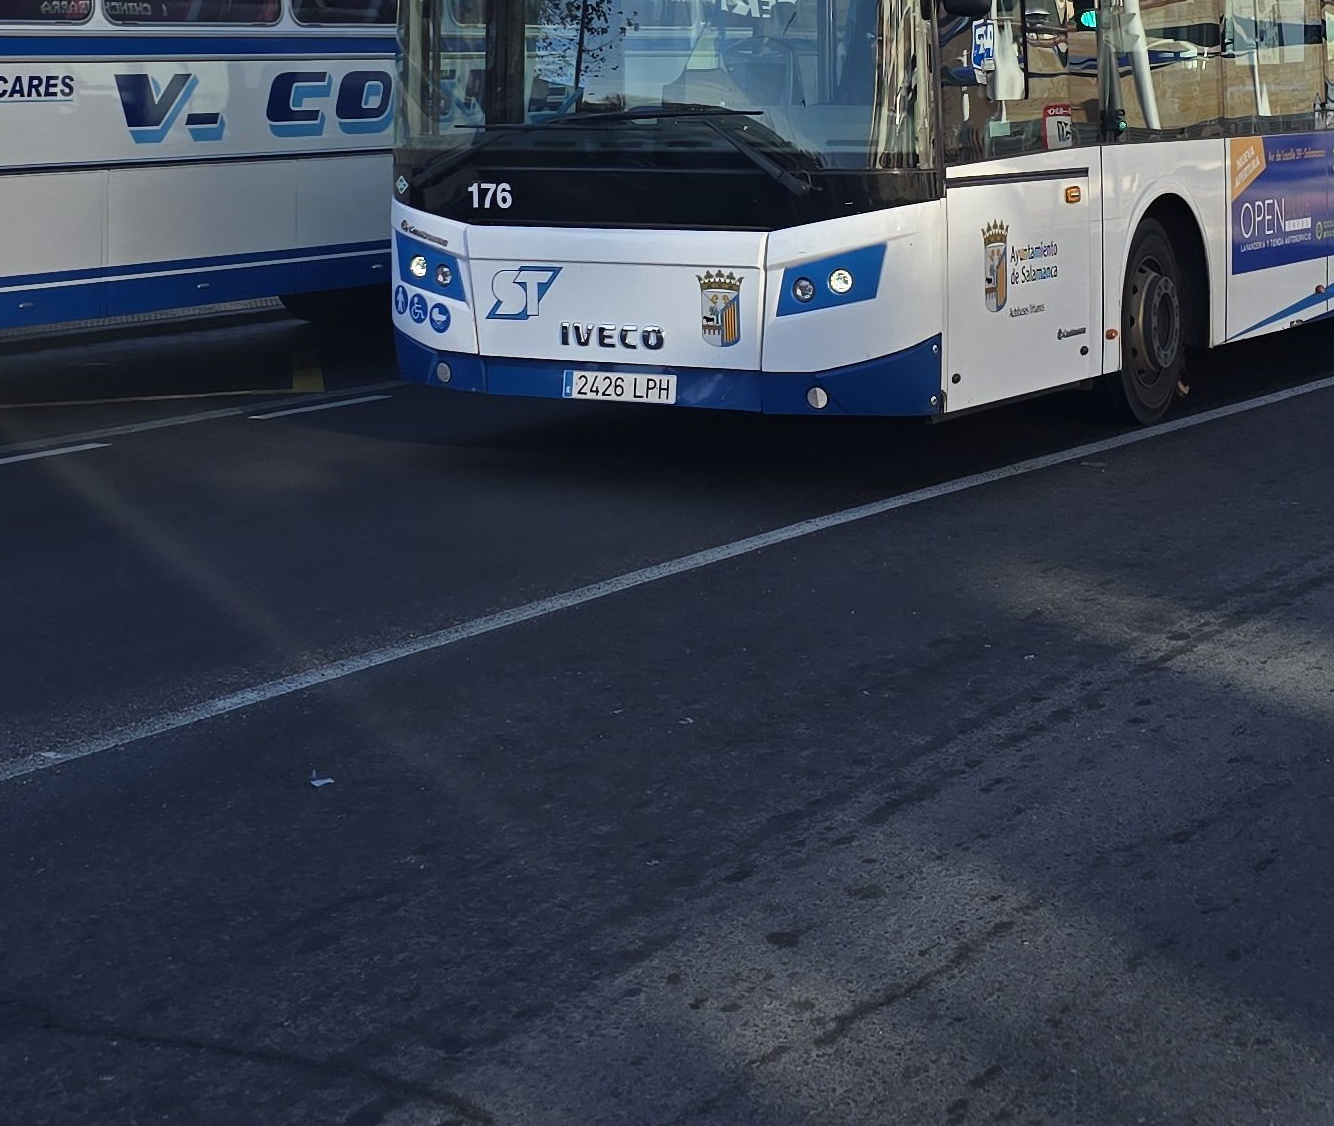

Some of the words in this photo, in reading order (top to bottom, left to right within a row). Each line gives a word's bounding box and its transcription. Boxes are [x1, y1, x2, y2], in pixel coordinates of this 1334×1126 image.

[467, 182, 513, 209] 176
[1240, 197, 1286, 239] OPEN
[1010, 240, 1058, 266] Ayuntamiento
[1010, 267, 1019, 285] de
[1021, 265, 1058, 284] Salamanca
[560, 322, 665, 351] IVECO
[577, 374, 625, 397] 2426
[632, 378, 670, 400] LPH
